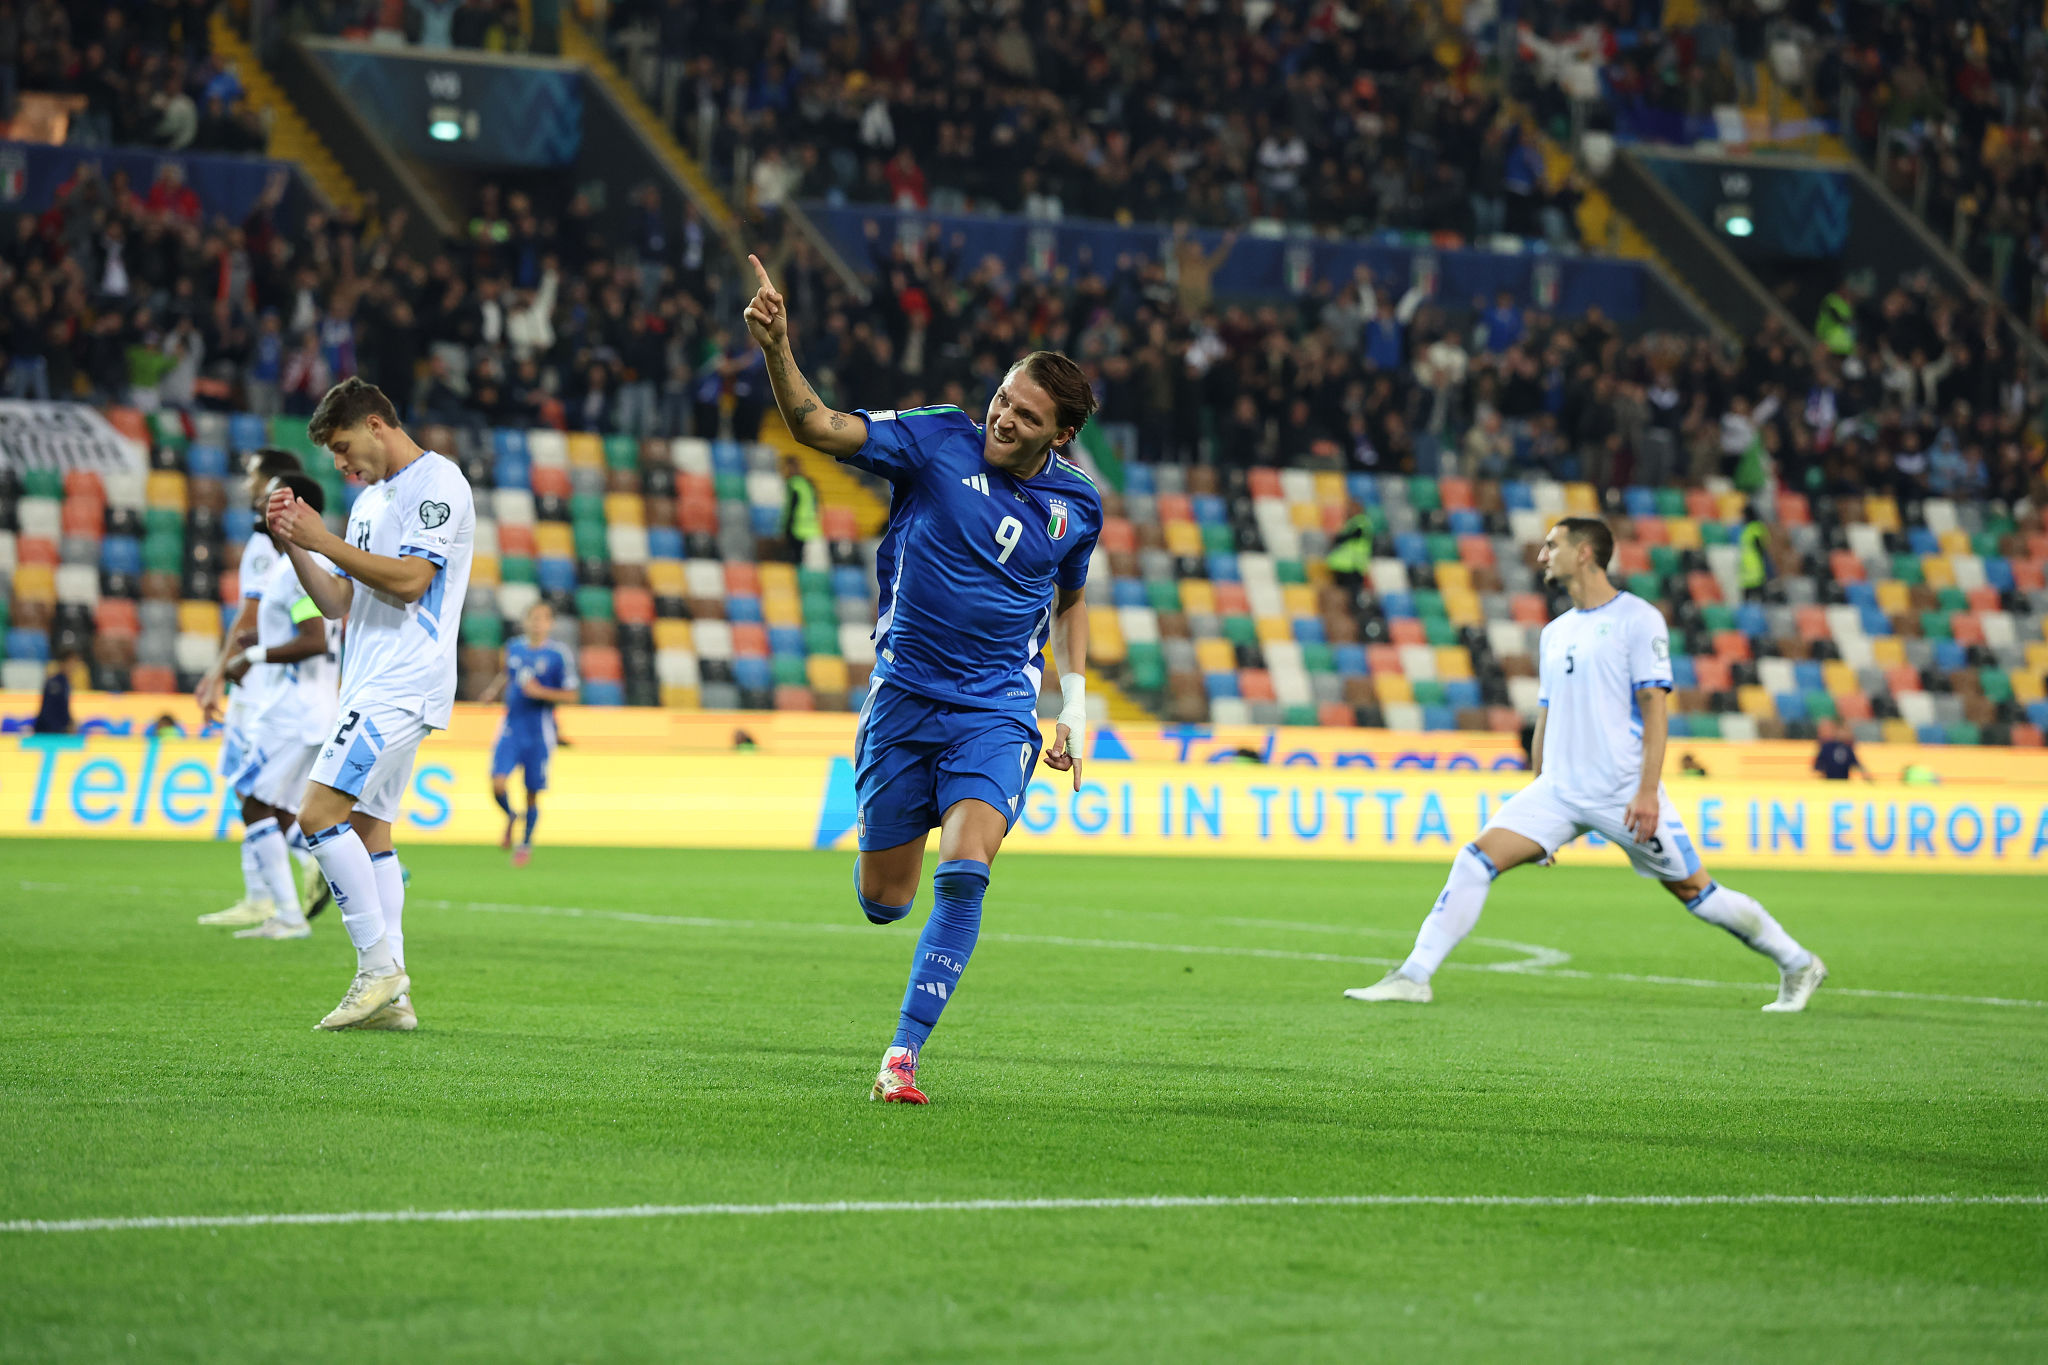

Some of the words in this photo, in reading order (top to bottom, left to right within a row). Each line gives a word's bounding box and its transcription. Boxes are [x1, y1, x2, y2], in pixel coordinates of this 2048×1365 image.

[995, 515, 1023, 565] 9
[19, 733, 455, 839] Teles
[1019, 780, 1131, 836] GGI
[1161, 784, 1222, 838] IN
[1249, 787, 1452, 842] TUTTA
[1699, 799, 1722, 849] E
[1750, 800, 1804, 851] IN
[925, 952, 963, 975] ITALIA
